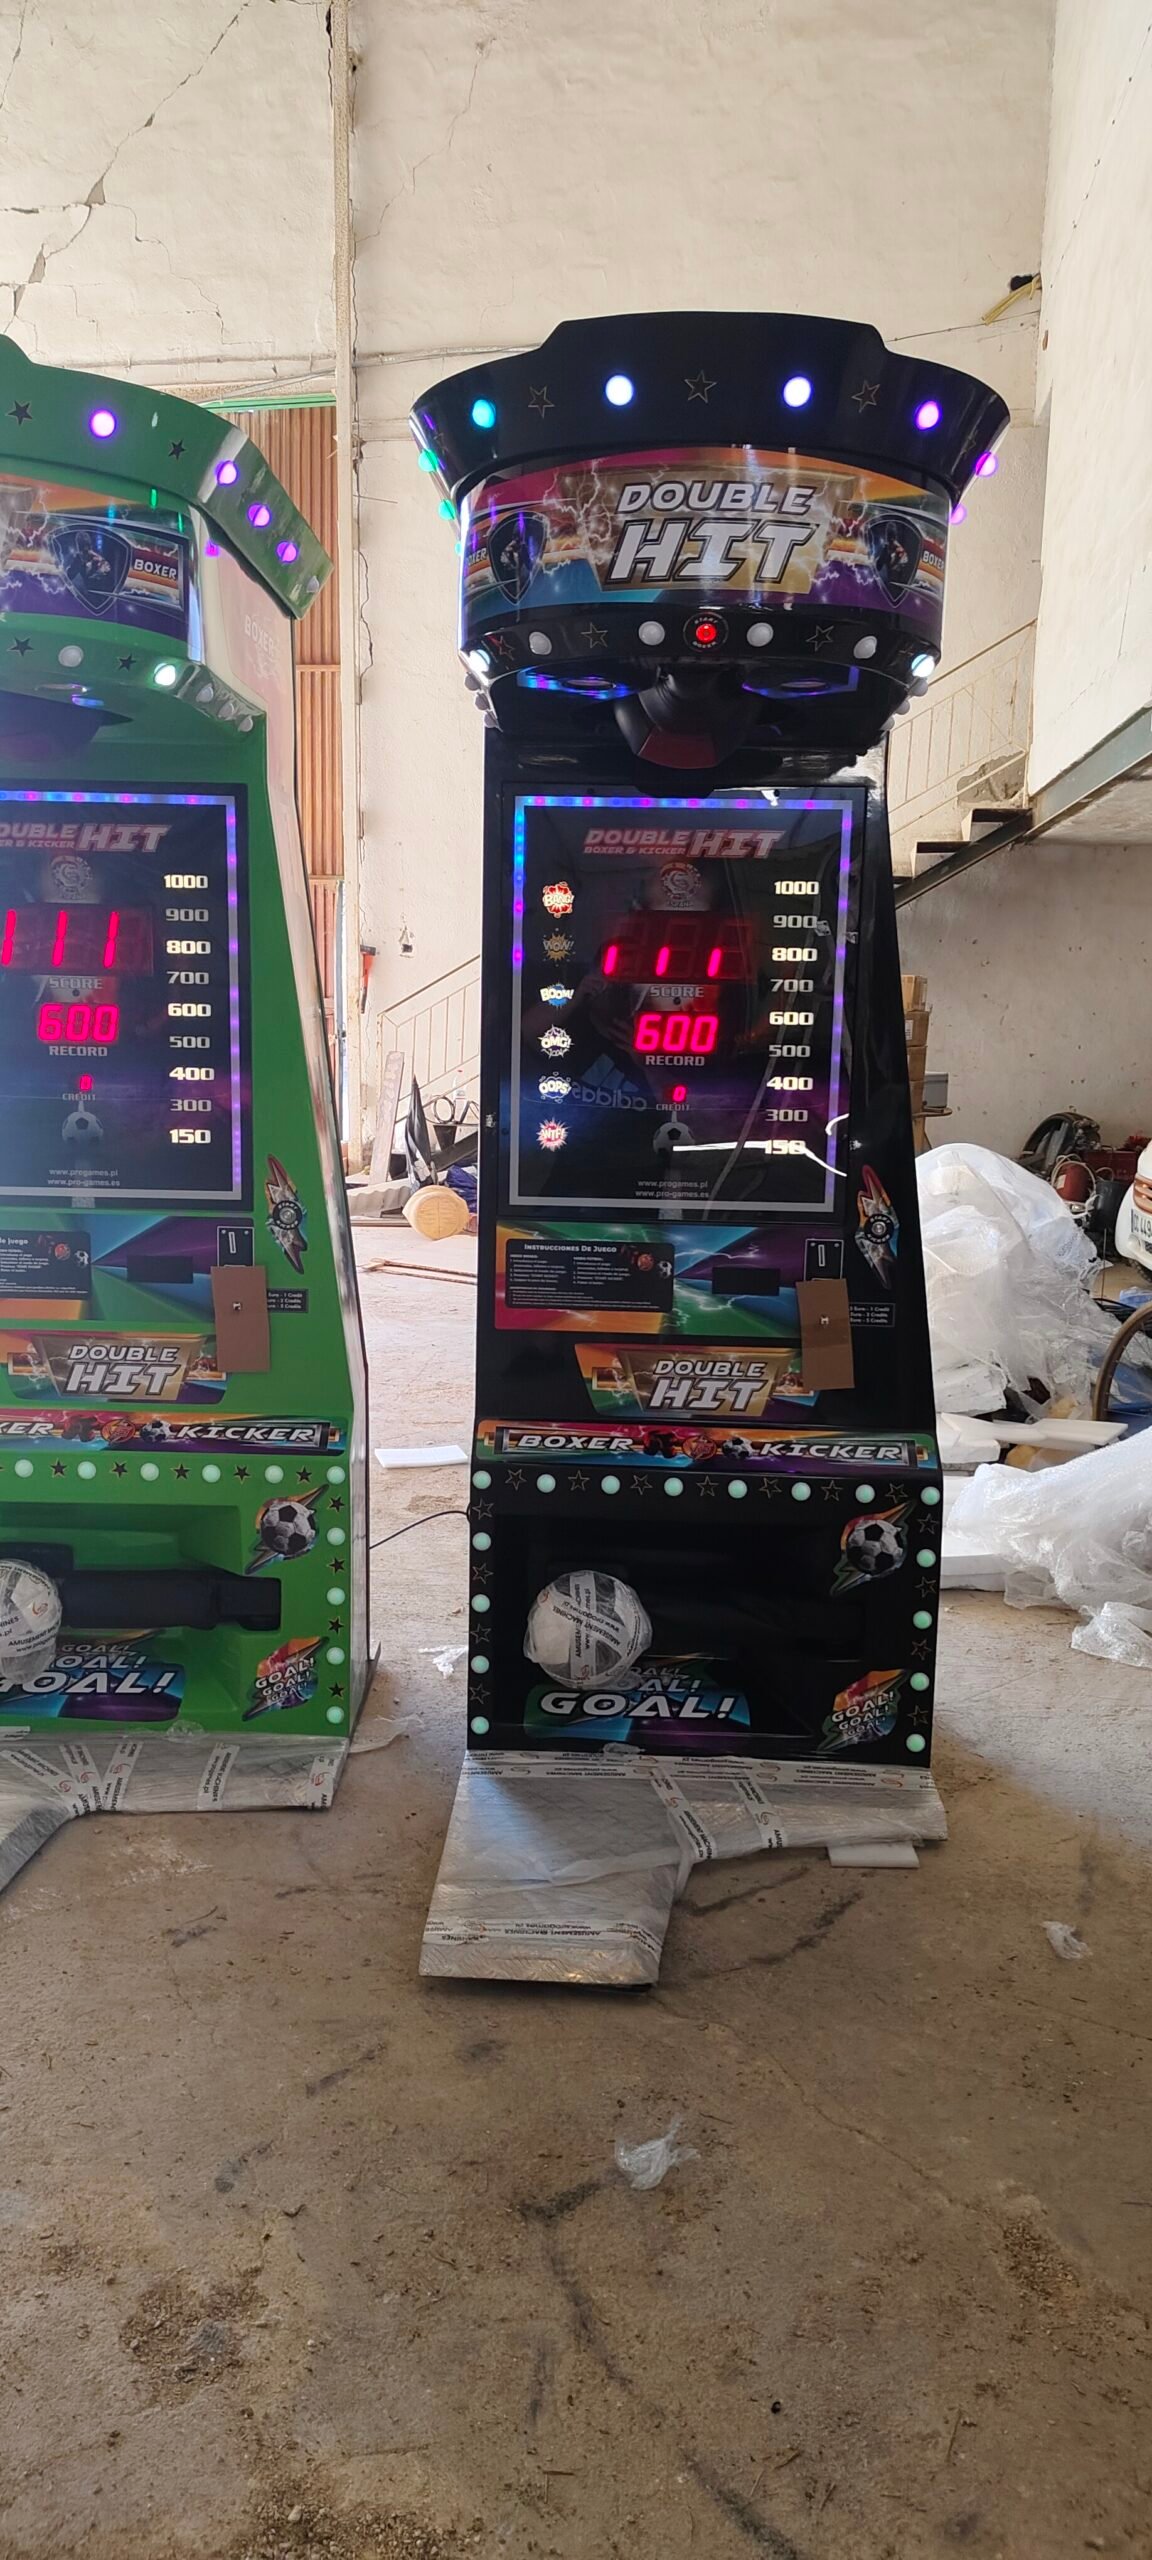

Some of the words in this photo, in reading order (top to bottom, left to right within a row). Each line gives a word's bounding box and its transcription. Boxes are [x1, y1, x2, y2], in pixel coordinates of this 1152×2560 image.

[615, 482, 815, 514] DOUBLE
[610, 520, 818, 582] HIT
[133, 558, 177, 580] BOXER
[0, 823, 78, 838] OUBLE
[78, 824, 172, 852] HIT
[28, 840, 75, 848] KICKER
[584, 829, 692, 845] DOUBLE
[688, 829, 786, 858] HIT
[583, 846, 623, 854] BOXER
[638, 846, 687, 855] KICKER
[163, 874, 208, 889] 1000
[774, 881, 819, 895] 1000
[543, 894, 575, 907] BANG!
[165, 908, 209, 922] 900
[773, 915, 817, 929] 900
[1, 910, 120, 969] 111
[166, 940, 211, 955] 800
[772, 947, 817, 962] 800
[49, 977, 103, 990] SCORE
[166, 971, 209, 985] 700
[650, 985, 705, 998] SCORE
[770, 979, 813, 993] 700
[540, 987, 575, 1001] BOOM!
[167, 1003, 211, 1017] 600
[37, 1003, 119, 1042] 600
[769, 1011, 814, 1025] 600
[634, 1014, 719, 1052] 600
[169, 1036, 210, 1049] 500
[541, 1036, 572, 1049] OMG!
[49, 1046, 108, 1057] RECORD
[768, 1045, 810, 1058] 500
[645, 1055, 705, 1066] RECORD
[169, 1067, 214, 1081] 400
[766, 1077, 813, 1091] 400
[62, 1093, 96, 1101] CREDIT
[170, 1099, 212, 1112] 300
[655, 1103, 690, 1111] CREDIT
[765, 1109, 808, 1122] 300
[169, 1129, 211, 1144] 150
[68, 1345, 180, 1363] DOUBLE
[653, 1359, 769, 1379] DOUBLE
[64, 1364, 181, 1395] HIT
[648, 1380, 768, 1411] HIT
[177, 1425, 315, 1443] KICKER
[517, 1434, 634, 1452] BOXER
[760, 1441, 901, 1460] KICKER
[51, 1655, 147, 1669] OAL!
[255, 1657, 314, 1689] GOAL!
[262, 1671, 310, 1696] GOAL!
[540, 1691, 736, 1719] GOAL!
[832, 1691, 894, 1722] GOAL!
[839, 1705, 889, 1730] GOAL!
